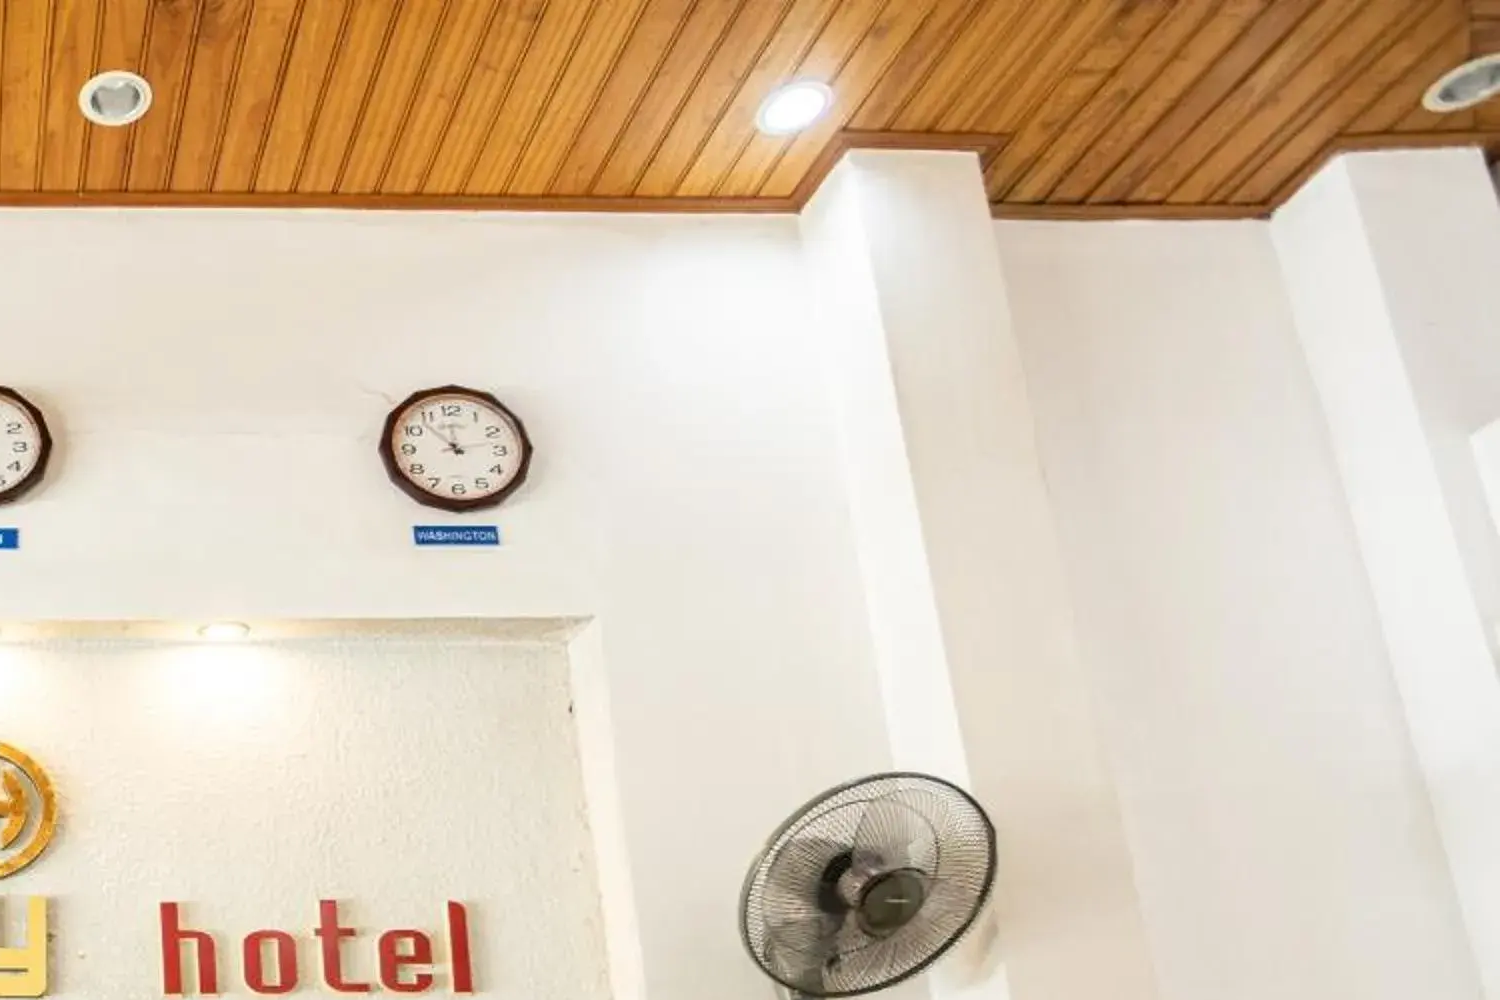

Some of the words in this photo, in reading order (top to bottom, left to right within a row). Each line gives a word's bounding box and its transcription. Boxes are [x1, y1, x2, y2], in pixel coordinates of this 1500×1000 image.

[421, 410, 434, 422] 11
[440, 404, 461, 417] 12
[6, 422, 23, 435] 2
[404, 424, 423, 438] 10
[484, 425, 501, 438] 2
[12, 440, 28, 453] 3
[401, 443, 417, 456] 9
[492, 445, 508, 457] 3
[6, 459, 21, 472] 4
[409, 462, 425, 475] 8
[489, 463, 503, 475] 4
[427, 477, 441, 489] 7
[451, 482, 467, 495] 6
[475, 477, 490, 490] 5
[417, 531, 496, 541] WASHINGTON
[158, 898, 476, 995] hotel
